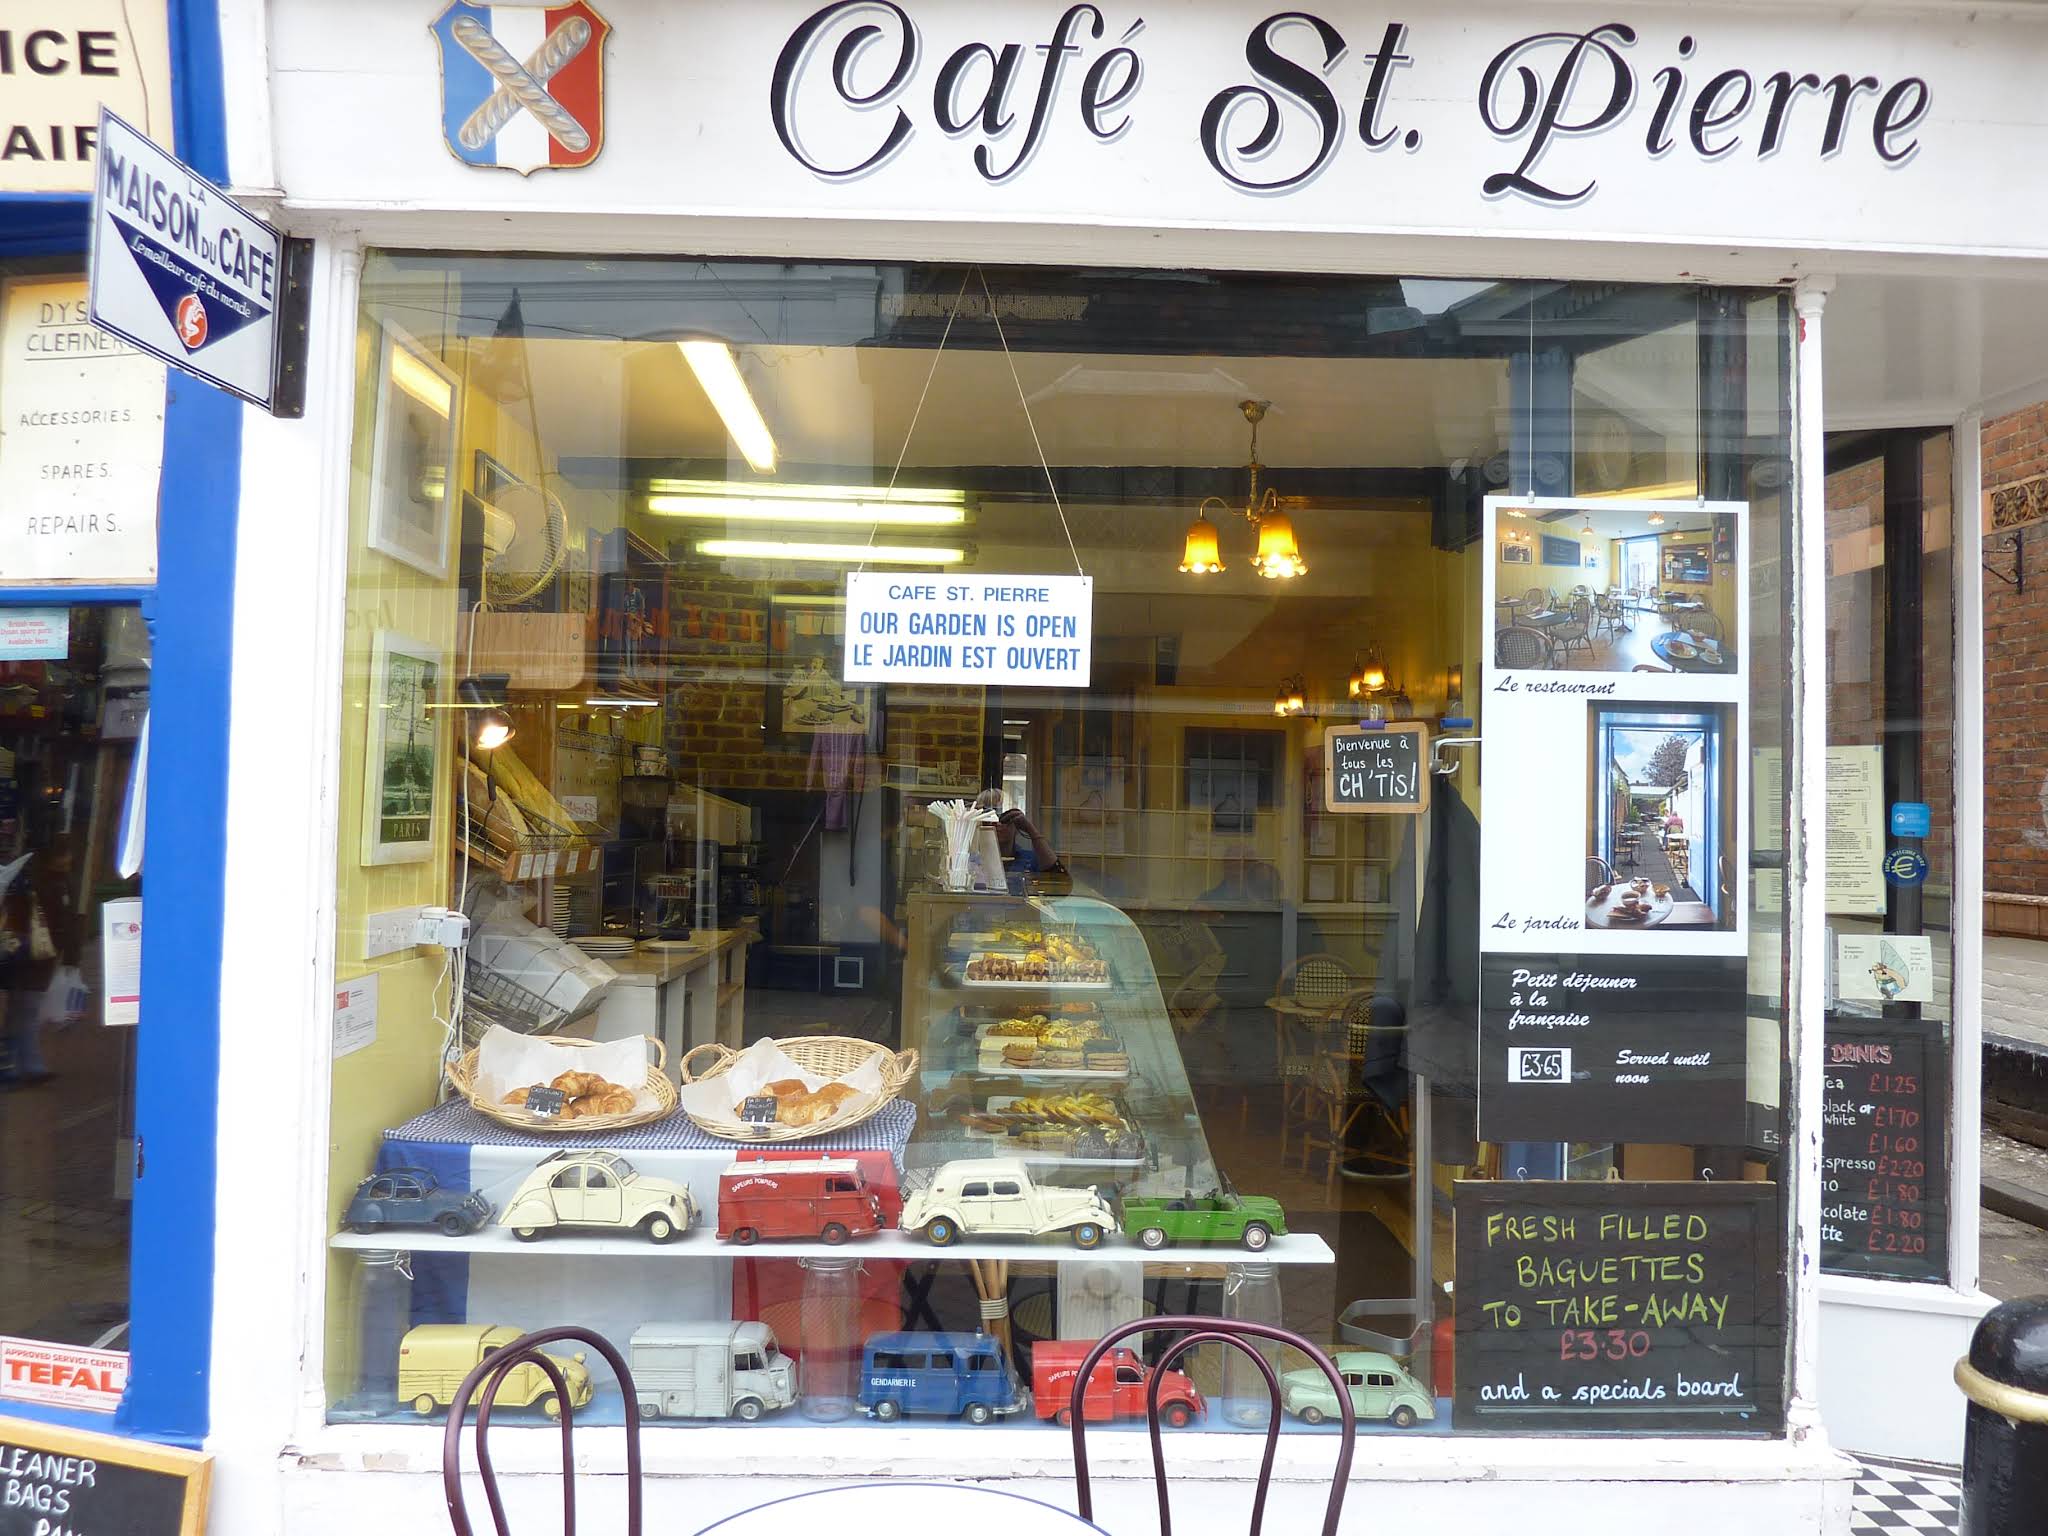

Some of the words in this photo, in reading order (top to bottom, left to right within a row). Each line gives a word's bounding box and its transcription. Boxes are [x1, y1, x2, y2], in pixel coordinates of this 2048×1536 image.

[770, 0, 1145, 184] Café
[1200, 11, 1421, 196] St.
[1478, 22, 1931, 205] Pierre
[189, 180, 206, 206] LA
[104, 146, 199, 255] MAISON
[202, 236, 217, 266] DU
[219, 228, 274, 302] CAFÉ
[888, 585, 937, 600] CAFE
[946, 586, 974, 601] ST.
[984, 587, 1049, 603] PIERRE
[860, 611, 898, 635] OUR
[909, 612, 986, 637] GARDEN
[997, 614, 1015, 638] IS
[1026, 615, 1077, 639] OPEN
[853, 644, 873, 666] LE
[883, 644, 952, 668] JARDIN
[962, 646, 997, 669] EST
[1007, 646, 1081, 671] OUVERT
[1494, 675, 1519, 693] Le
[1525, 680, 1616, 695] restaurant
[1335, 738, 1392, 753] Bienvenue
[1341, 755, 1366, 770] tous
[1376, 753, 1394, 769] les
[393, 822, 421, 838] PARIS
[1491, 912, 1517, 930] Le
[1522, 914, 1580, 934] jardin
[1511, 968, 1558, 989] Petit
[1562, 971, 1637, 993] déjeuner
[1510, 991, 1523, 1007] à
[1528, 990, 1548, 1007] la
[1508, 1009, 1590, 1030] française
[1615, 1049, 1668, 1066] Served
[1673, 1051, 1711, 1067] until
[1831, 1043, 1892, 1065] DRINKS
[1615, 1073, 1650, 1084] noon
[1859, 1103, 1876, 1115] or
[1820, 1203, 1868, 1221] colate
[1486, 1212, 1576, 1247] FRESH
[1599, 1214, 1708, 1242] FILLED
[1516, 1252, 1705, 1288] BAGUETTES
[1482, 1300, 1522, 1328] TO
[1536, 1292, 1729, 1330] TAKE-AWAY
[5, 1348, 52, 1360] APPROVED
[52, 1353, 88, 1365] SERVICE
[90, 1358, 124, 1369] CENTRE
[5, 1358, 123, 1394] TEFAL
[870, 1377, 917, 1388] GENDARMERIE
[1481, 1372, 1530, 1401] and
[1541, 1385, 1562, 1400] a
[1572, 1377, 1666, 1405] specials
[1677, 1372, 1744, 1398] board
[6, 1479, 72, 1514] BAGS
